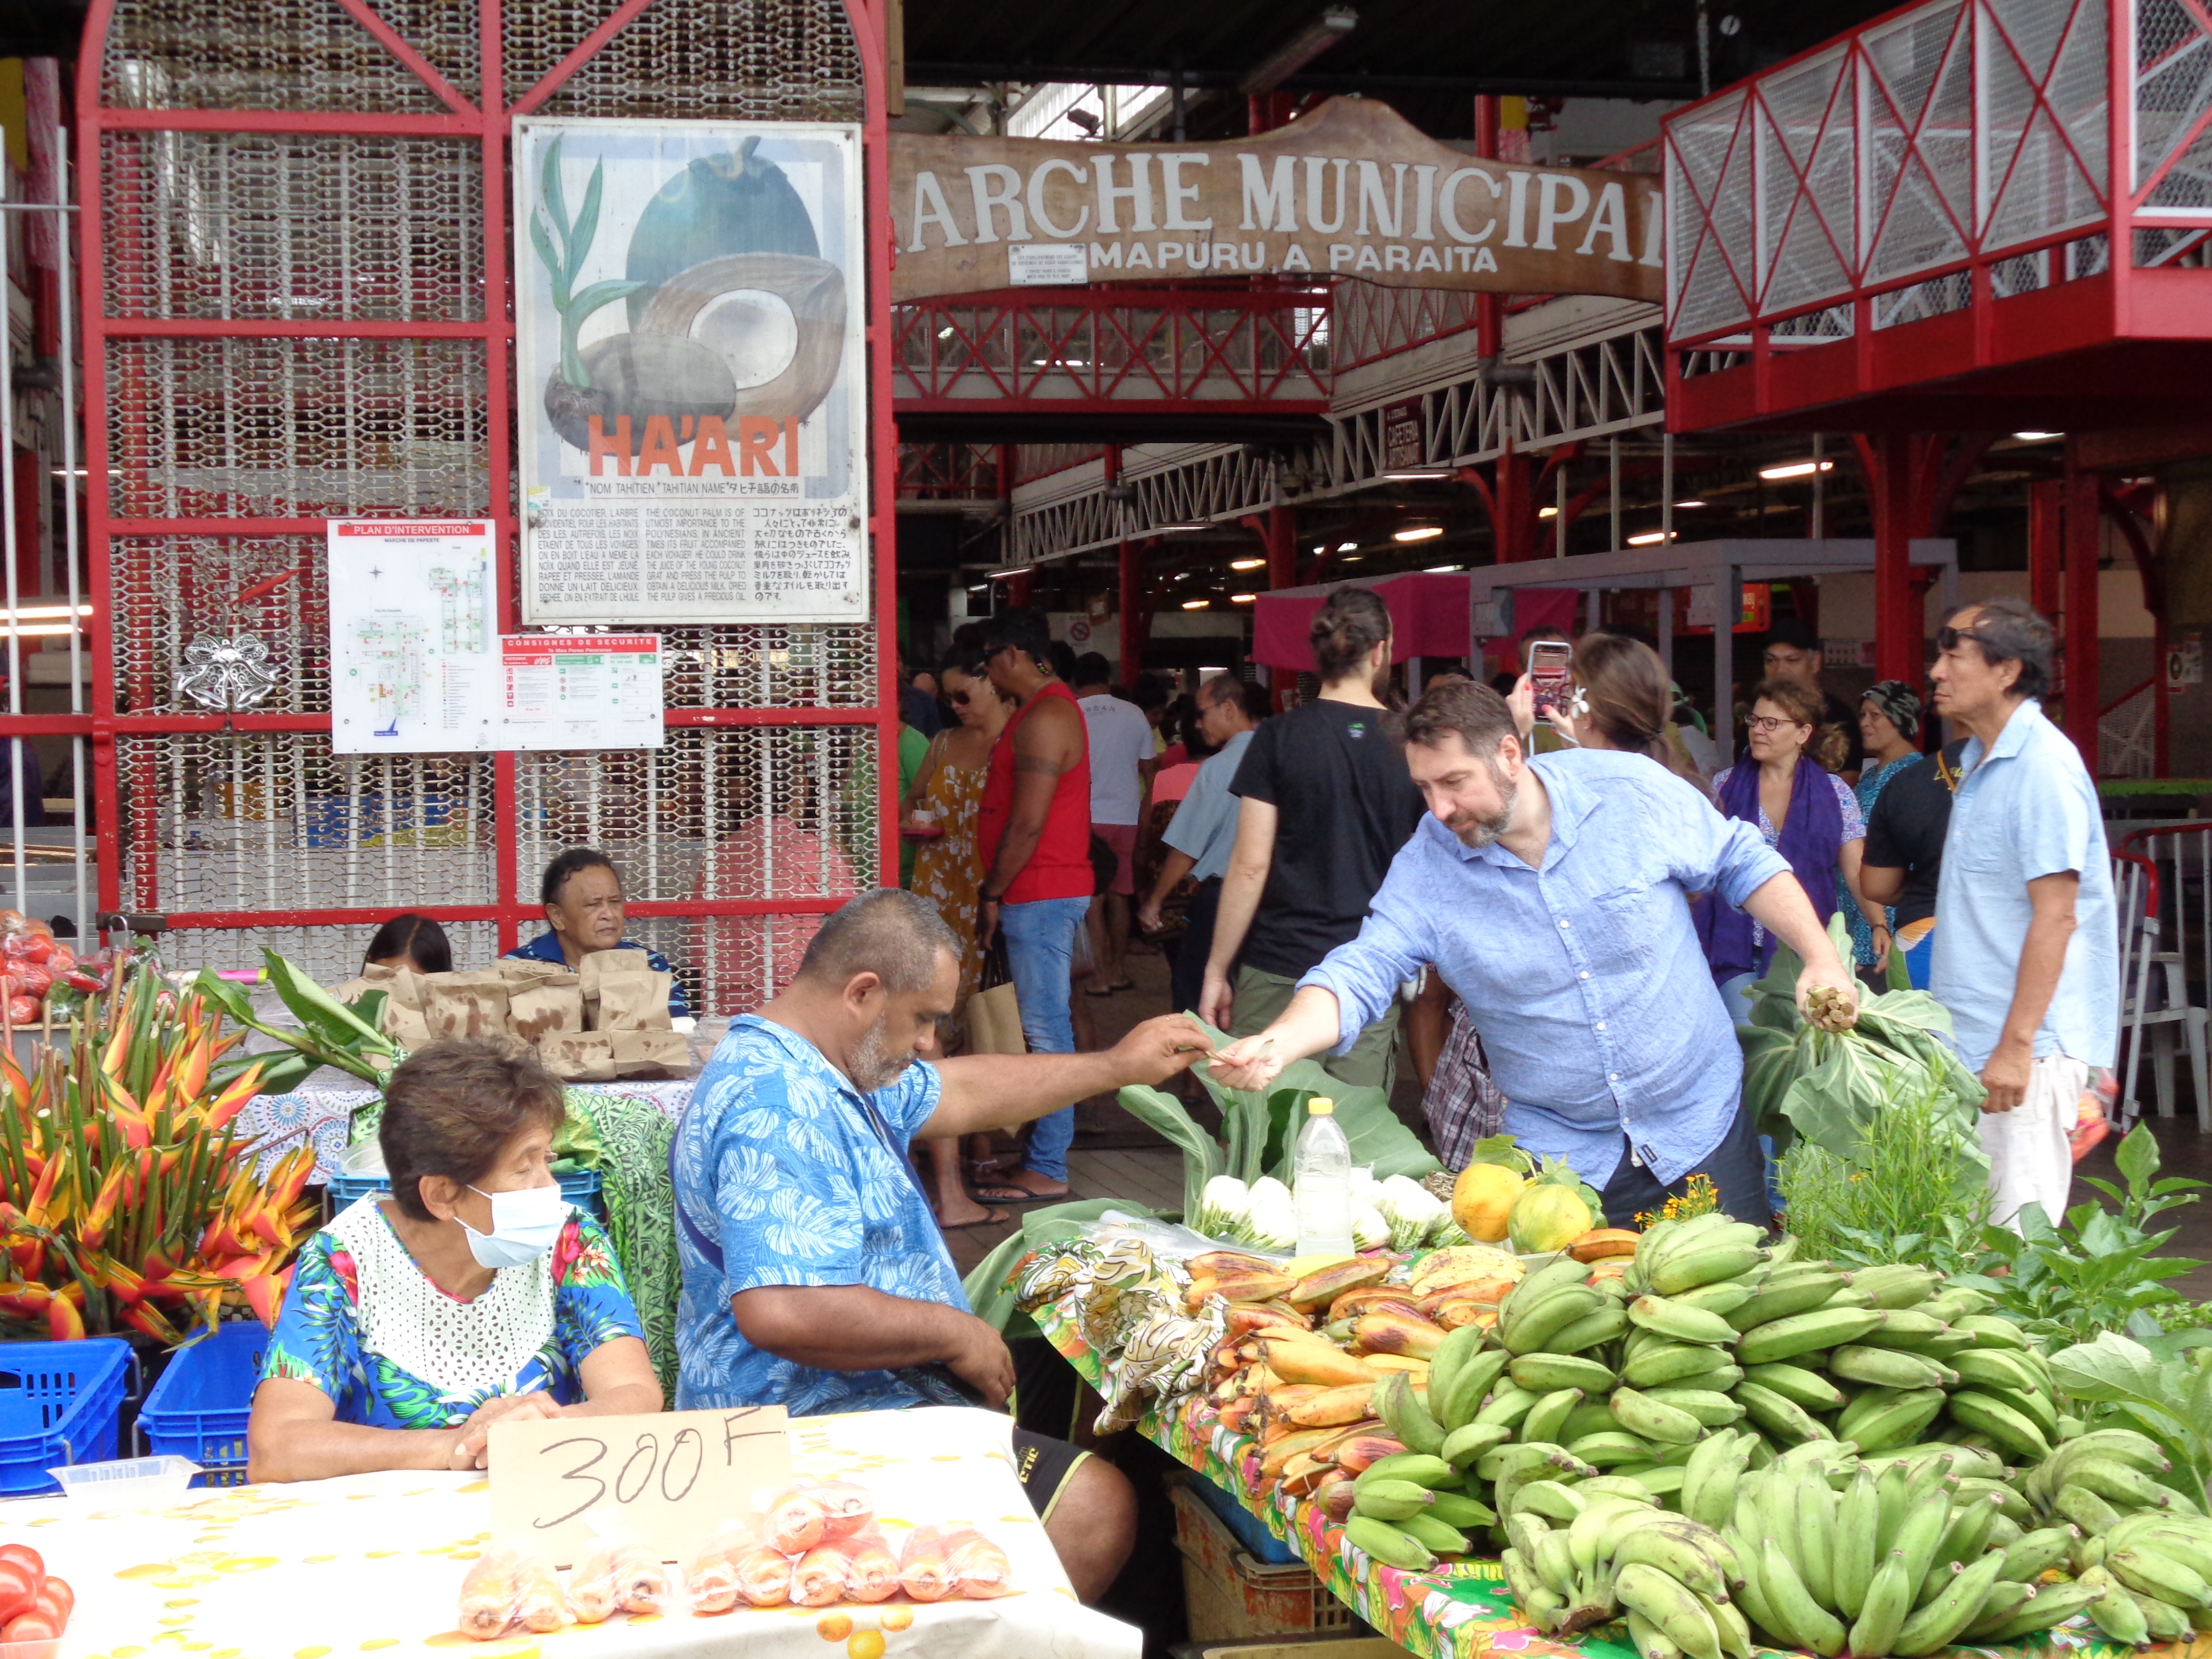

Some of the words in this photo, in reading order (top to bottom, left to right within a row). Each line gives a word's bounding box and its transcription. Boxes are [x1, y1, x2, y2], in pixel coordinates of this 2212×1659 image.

[895, 152, 1213, 254] ARCHE
[1090, 240, 1266, 270] MAPURU
[1283, 243, 1310, 271] A
[1329, 243, 1498, 273] PARAITA
[588, 415, 799, 477] HA'ARI
[702, 483, 726, 494] NAME
[557, 508, 567, 517] DU
[646, 508, 660, 517] THE
[663, 508, 699, 517] COCONUT
[702, 508, 722, 517] PALM
[725, 508, 732, 517] IS
[735, 508, 745, 517] OF
[537, 519, 577, 528] OVIDENTIEL
[578, 519, 593, 528] POUR
[596, 519, 607, 528] LES
[609, 519, 638, 528] HABITANTS
[645, 519, 673, 527] UTMOST
[676, 519, 717, 527] IMPORTANCE
[720, 519, 729, 527] TO
[732, 519, 745, 527] THE
[353, 526, 382, 535] PLAN
[384, 525, 470, 535] D'INTERVENTION
[538, 530, 550, 538] DES
[609, 530, 620, 538] LES
[623, 530, 638, 538] NOIX
[702, 529, 709, 538] IN
[713, 529, 745, 538] ANCIENT
[538, 541, 562, 549] ETAIENT
[565, 541, 574, 549] DE
[577, 541, 593, 549] TOUS
[596, 541, 607, 549] LES
[646, 540, 665, 548] TIMES
[667, 540, 677, 548] ITS
[680, 540, 698, 548] FRUIT
[701, 540, 746, 548] ACCOMPANIED
[538, 551, 548, 559] ON
[551, 551, 560, 559] EN
[562, 551, 577, 559] BOIT
[602, 551, 606, 559] A
[609, 551, 627, 559] MEME
[630, 551, 639, 559] LA
[646, 550, 662, 559] EACH
[665, 550, 691, 559] VOYAGER
[695, 550, 703, 559] HE
[705, 550, 726, 559] COULD
[728, 550, 745, 559] DRINK
[538, 561, 554, 570] NOIX
[557, 561, 580, 570] QUAND
[583, 561, 599, 570] ELLE
[602, 561, 614, 570] EST
[647, 561, 657, 569] THE
[659, 561, 674, 569] JUICE
[676, 561, 684, 569] OF
[686, 561, 696, 569] THE
[699, 561, 717, 569] YOUNG
[719, 561, 746, 569] COCONUT
[538, 572, 560, 580] RAPEE
[563, 572, 571, 580] ET
[647, 571, 662, 580] GRAT
[666, 571, 678, 580] AND
[681, 571, 702, 580] PRESS
[705, 571, 717, 580] THE
[719, 571, 735, 580] PULP
[738, 571, 746, 580] TO
[538, 582, 564, 591] DONNE
[568, 582, 577, 591] UN
[581, 582, 597, 591] LAIT
[647, 582, 668, 590] OBTAIN
[670, 582, 675, 590] A
[677, 582, 708, 590] DELICIOUS
[729, 582, 746, 590] DRIED
[564, 593, 572, 602] ON
[574, 593, 583, 602] EN
[610, 593, 617, 602] DE
[647, 592, 659, 601] THE
[661, 592, 676, 601] PULP
[678, 592, 696, 601] GIVES
[698, 592, 702, 601] A
[705, 592, 733, 601] PRECIOUS
[1082, 705, 1115, 714] RBAN
[532, 1428, 703, 1529] 300
[724, 1406, 785, 1467] F
